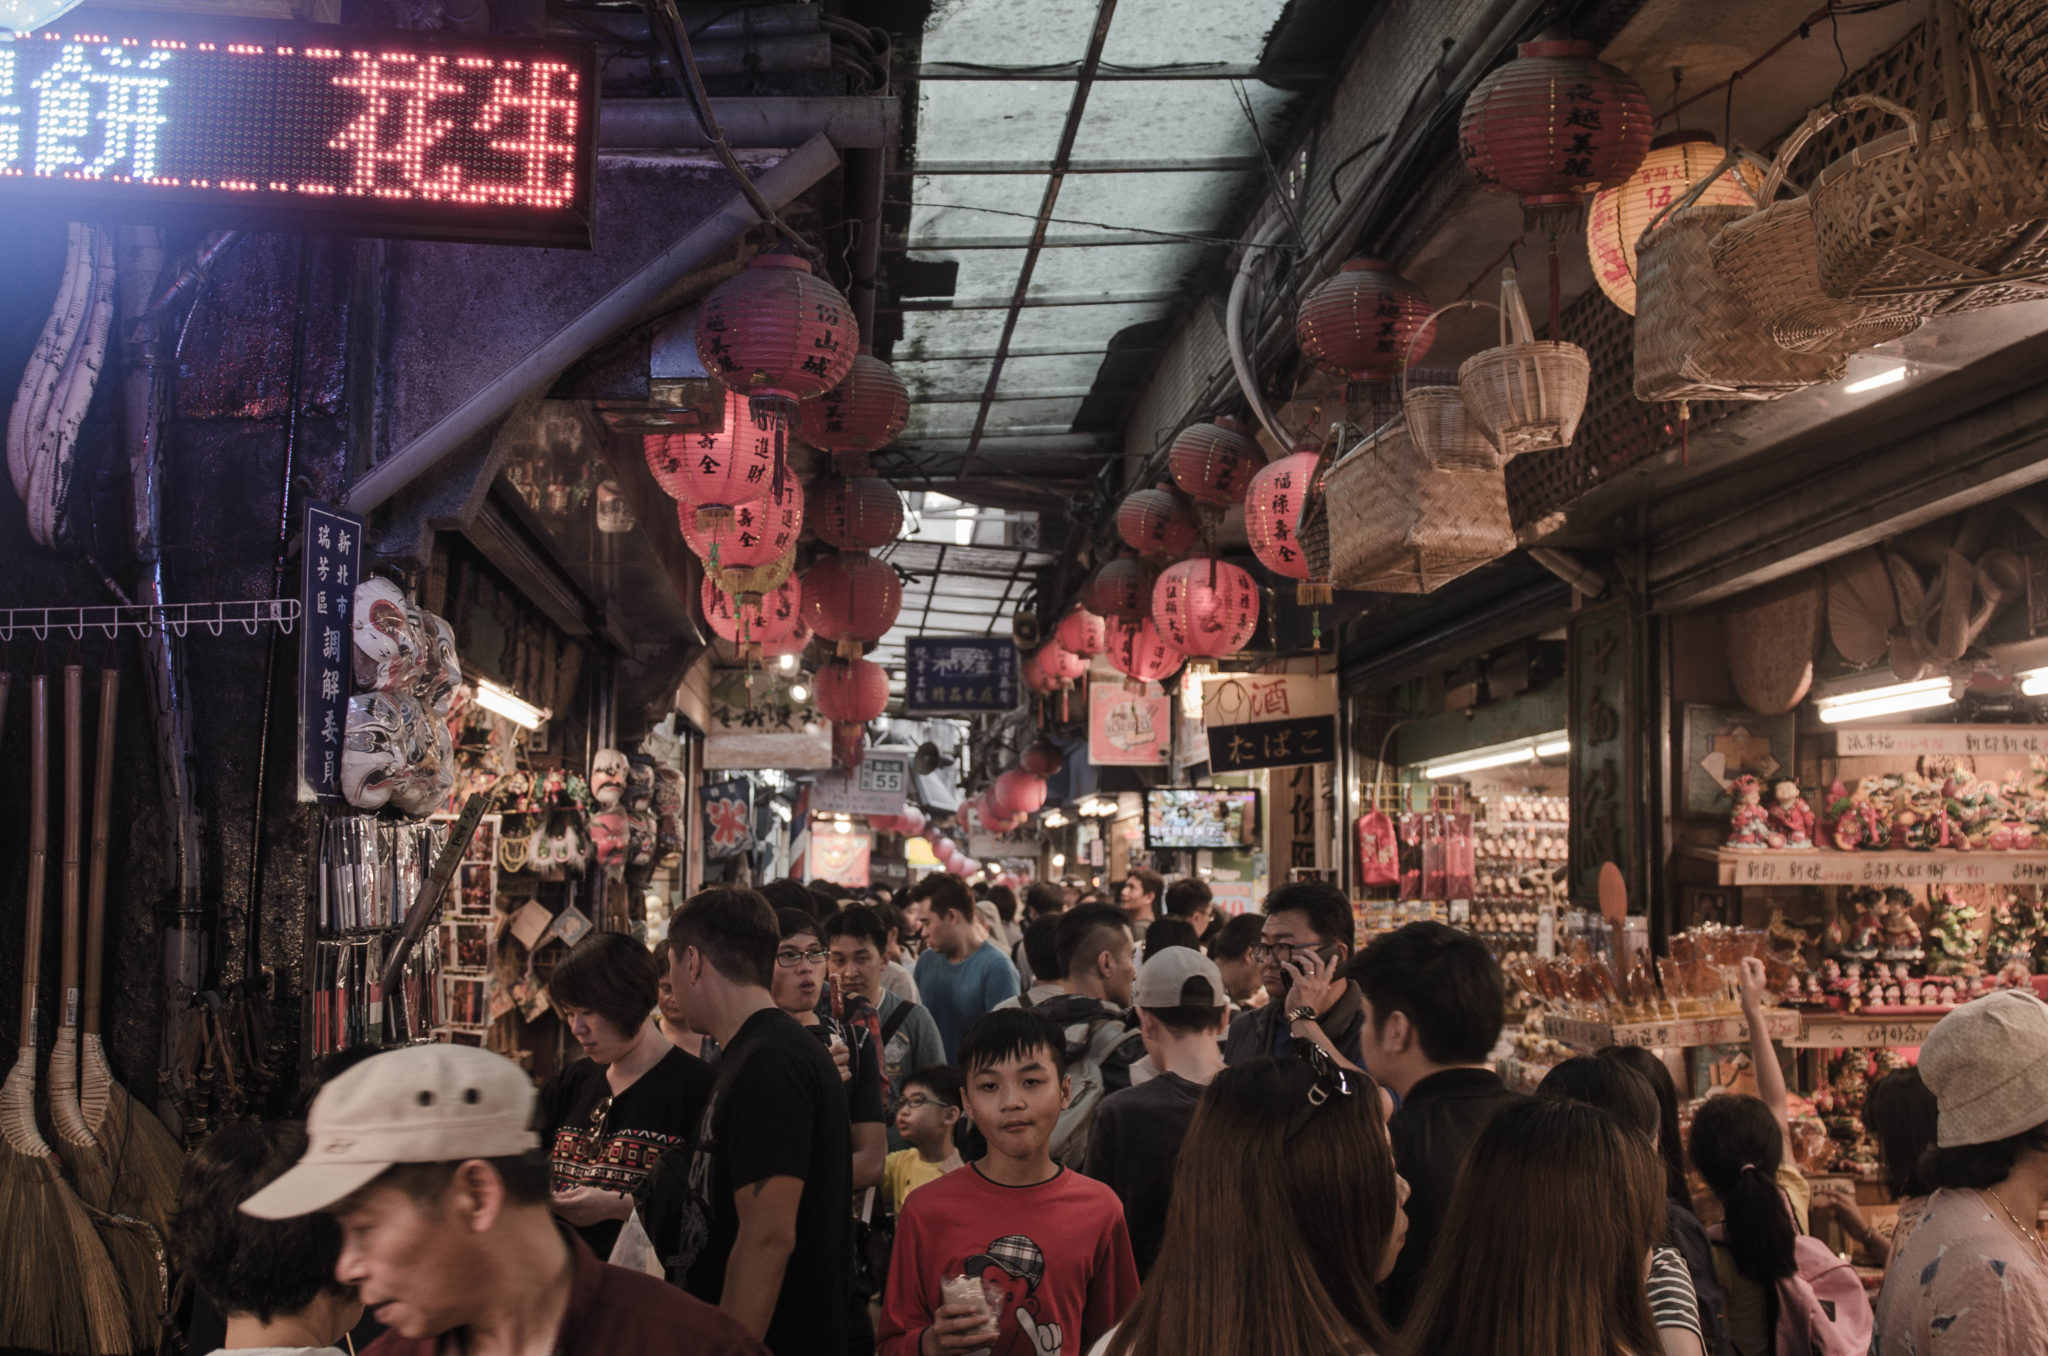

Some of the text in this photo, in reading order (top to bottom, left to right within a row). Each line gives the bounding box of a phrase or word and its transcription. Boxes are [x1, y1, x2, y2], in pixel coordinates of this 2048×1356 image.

[0, 43, 576, 208] 餅 花生
[1271, 470, 1298, 563] 福祿壽全
[315, 523, 332, 616] 瑞芳區
[335, 528, 352, 621] 新北市
[319, 625, 342, 786] 調解委員
[1250, 678, 1292, 718] 酒
[875, 774, 899, 789] 55
[1226, 727, 1324, 765] たばこ
